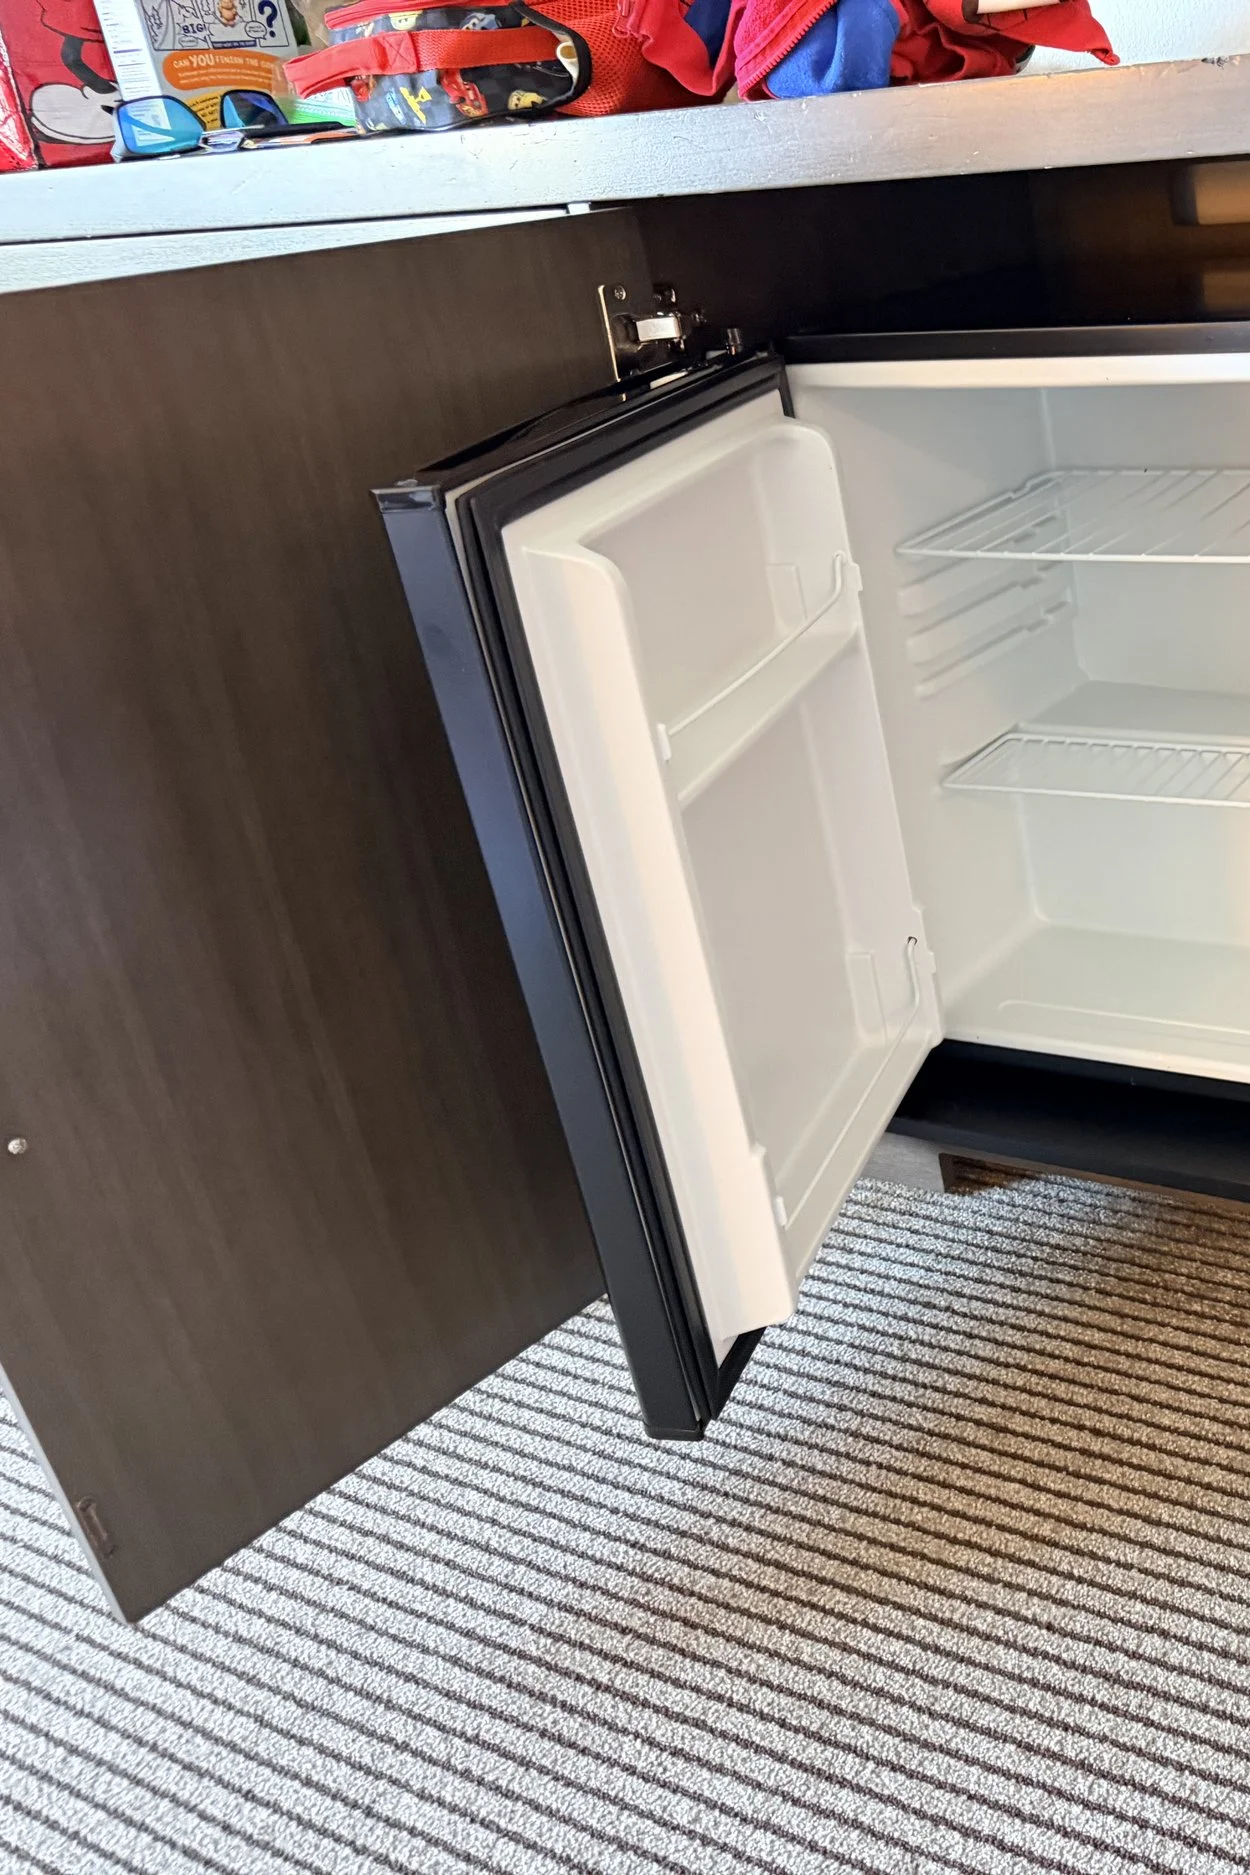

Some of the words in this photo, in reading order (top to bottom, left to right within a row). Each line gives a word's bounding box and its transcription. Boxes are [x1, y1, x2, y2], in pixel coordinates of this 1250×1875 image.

[182, 23, 207, 34] BIG!
[173, 58, 190, 69] CAN
[188, 53, 216, 67] YOU
[215, 55, 244, 65] FINISH
[246, 57, 259, 66] THE
